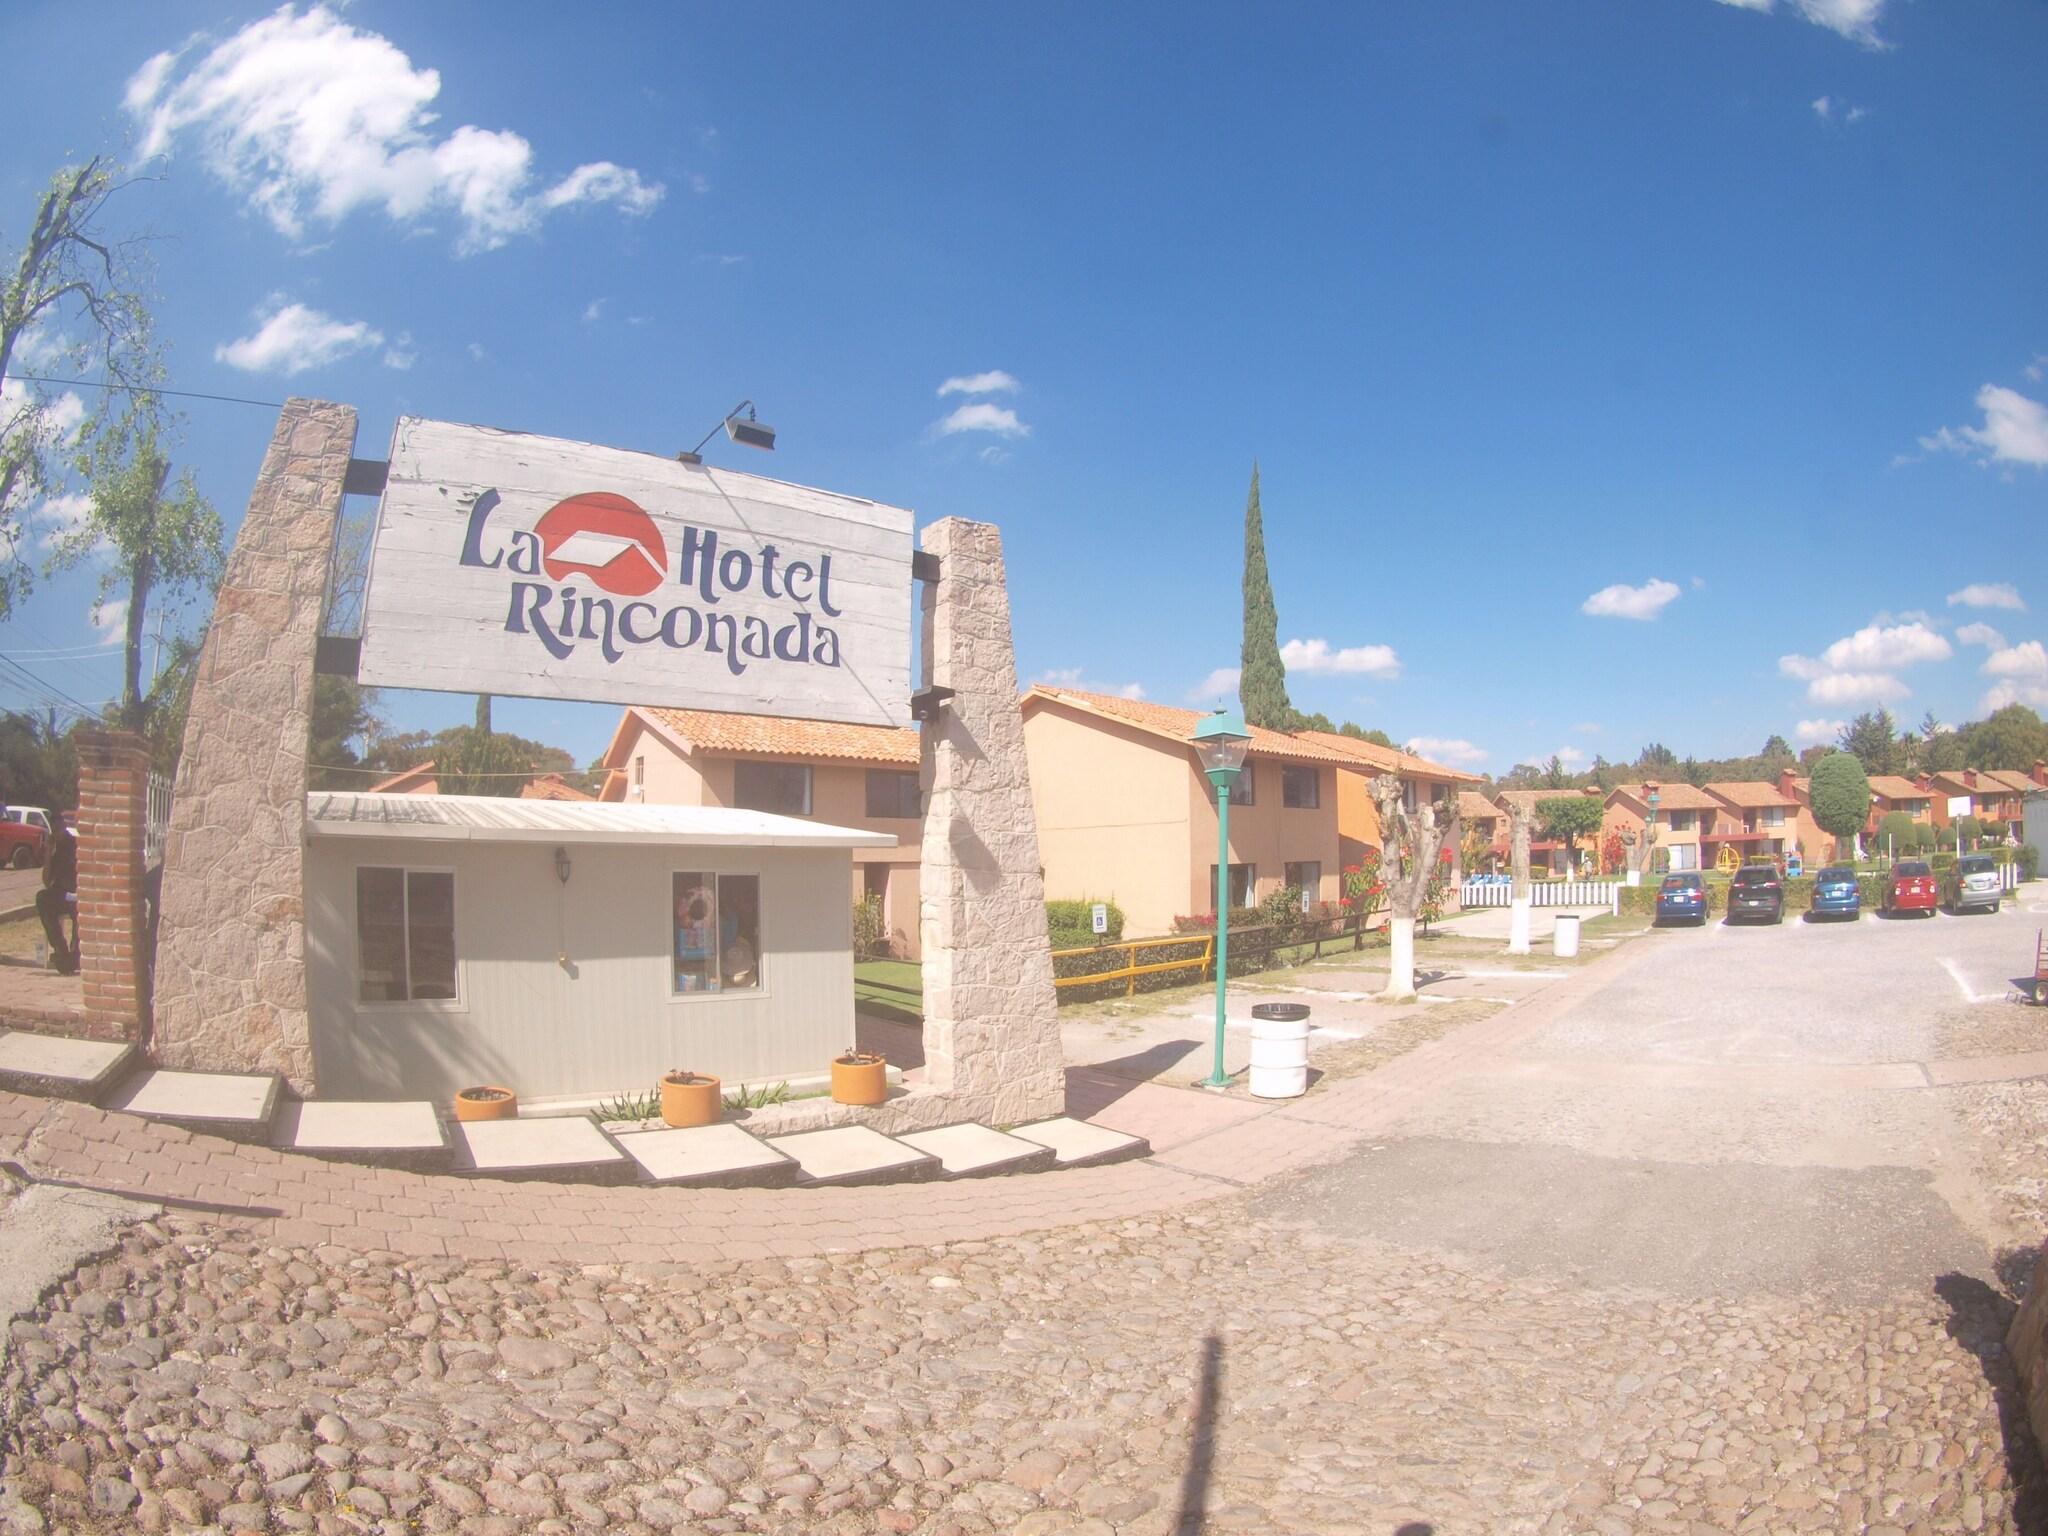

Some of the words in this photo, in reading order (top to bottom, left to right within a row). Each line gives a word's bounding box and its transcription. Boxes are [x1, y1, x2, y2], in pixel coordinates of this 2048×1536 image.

[460, 488, 540, 575] La
[680, 526, 841, 616] Hotel
[505, 583, 841, 674] Rinconada
